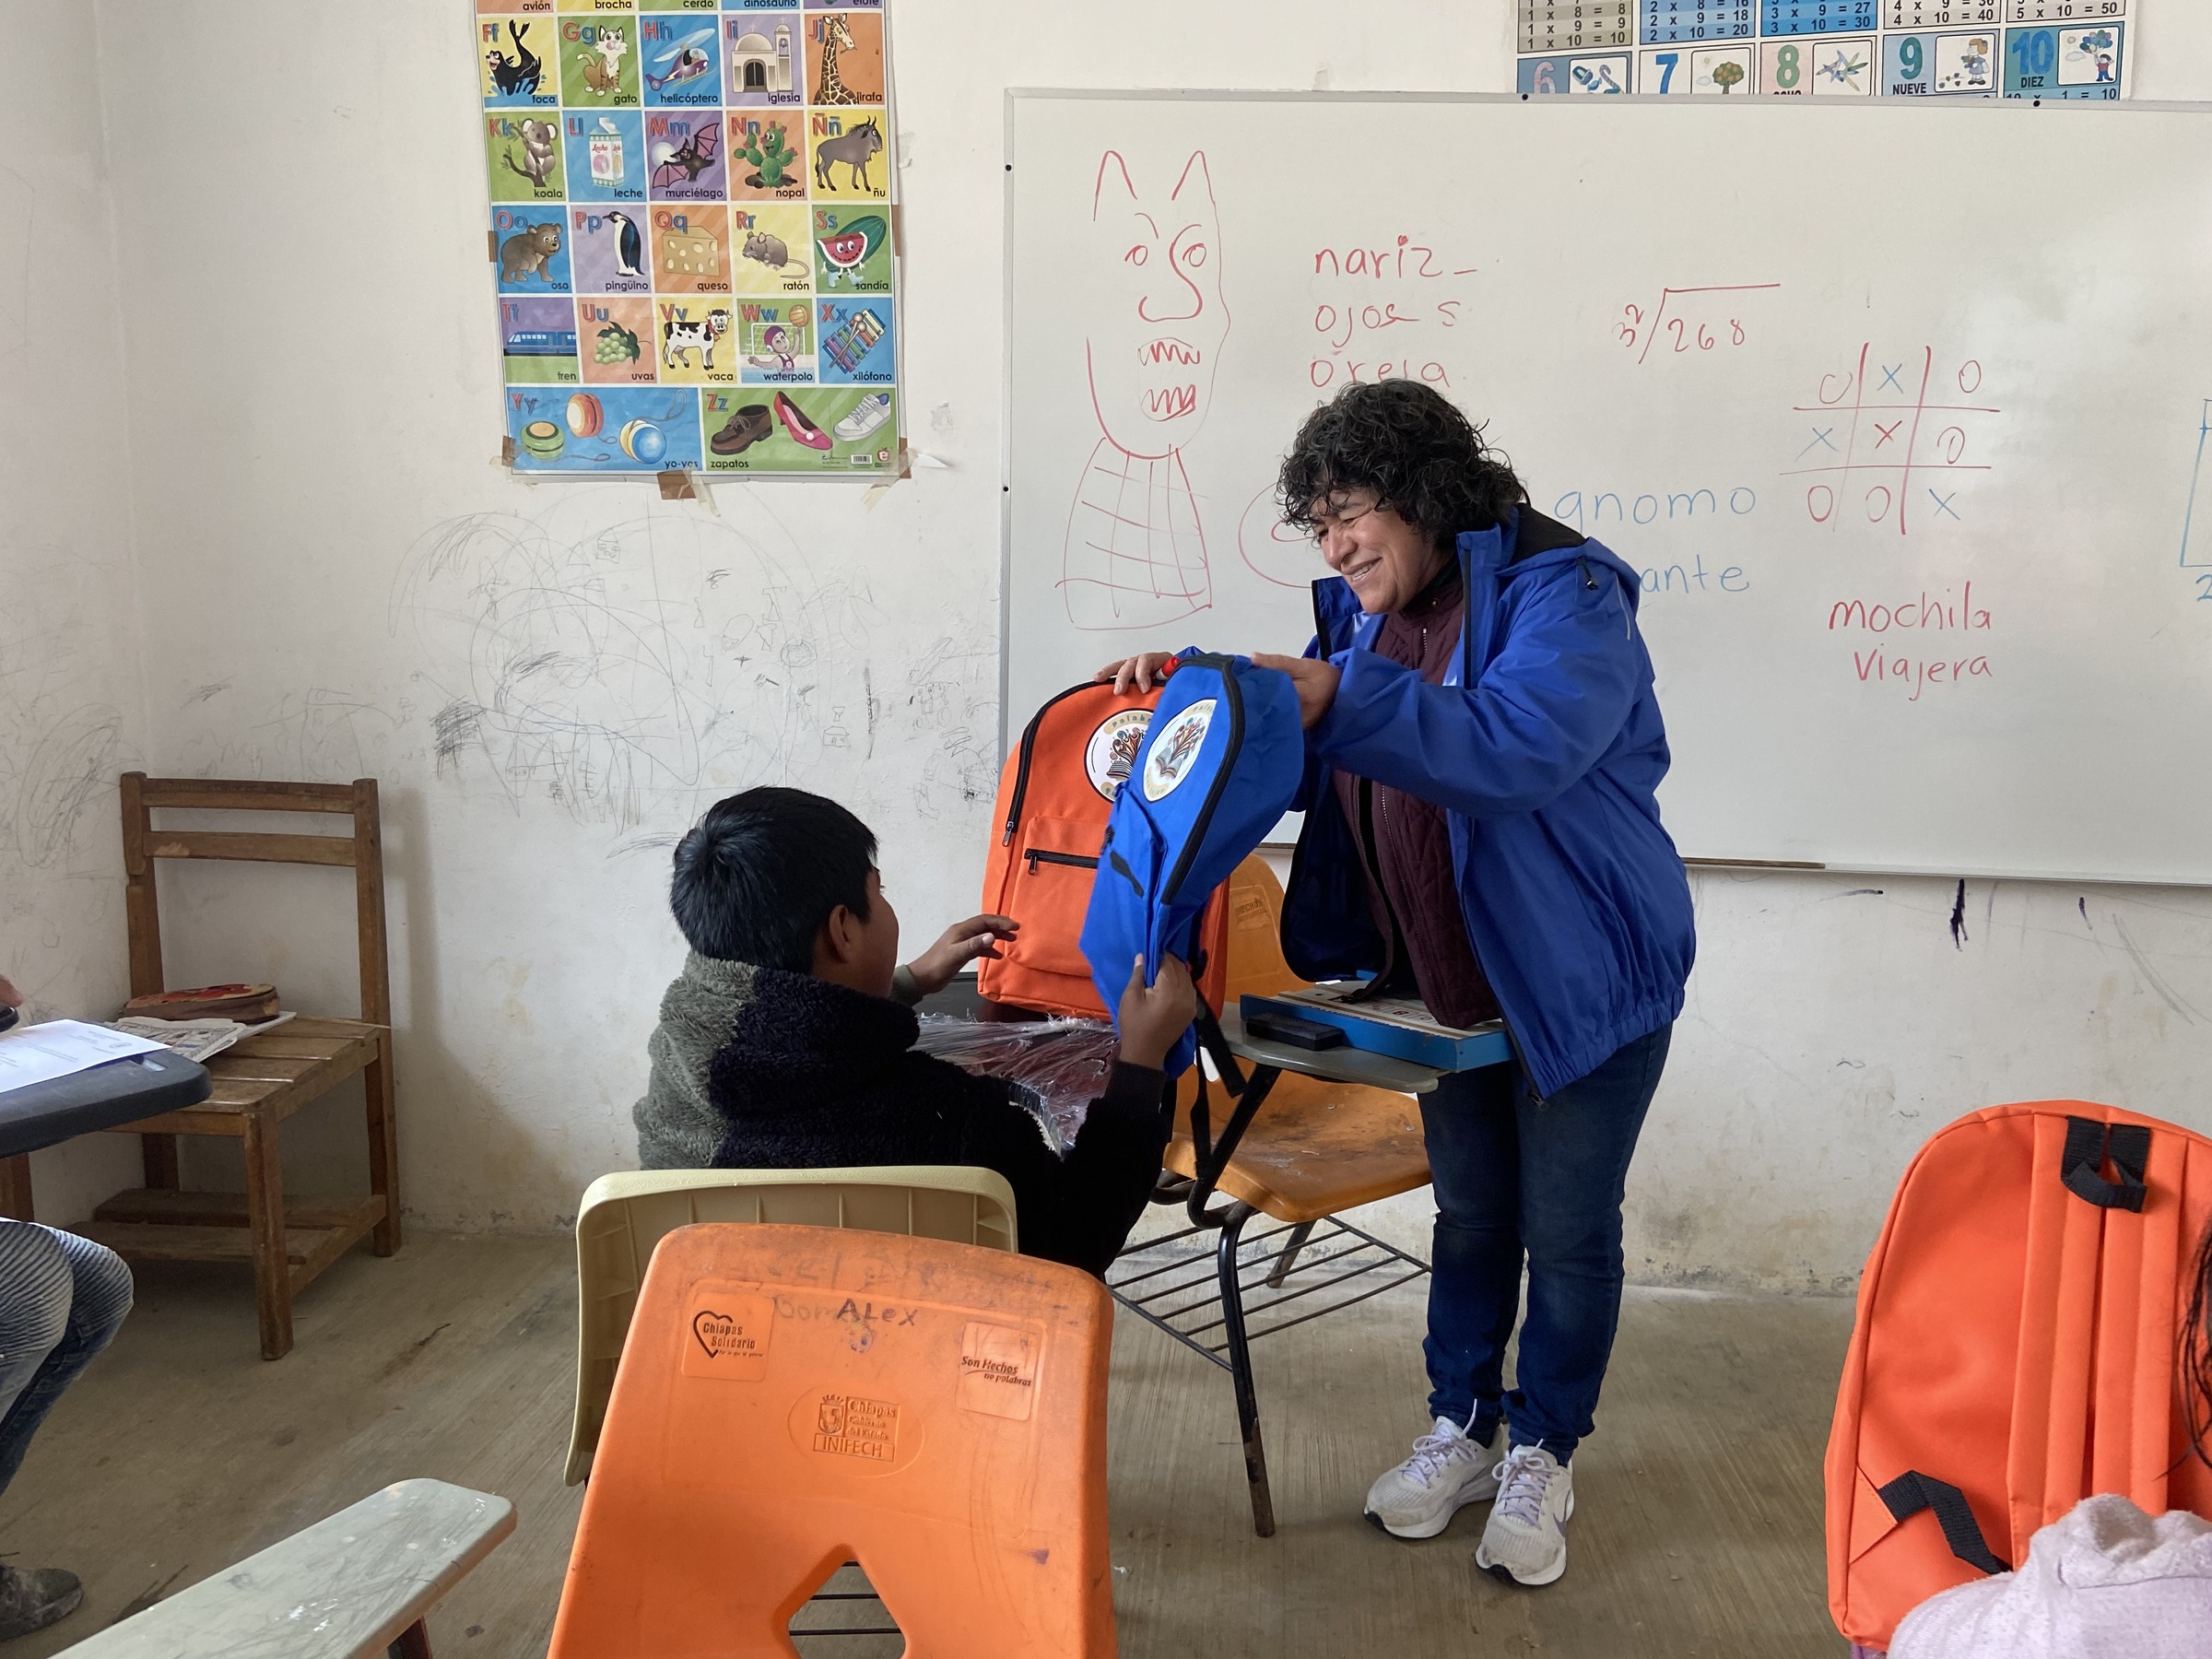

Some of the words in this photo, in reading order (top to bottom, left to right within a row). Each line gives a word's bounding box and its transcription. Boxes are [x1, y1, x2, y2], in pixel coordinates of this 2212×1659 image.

[523, 0, 551, 11] avión
[595, 0, 632, 9] brocha
[1771, 7, 1779, 18] 3
[1791, 8, 1799, 18] x
[1818, 5, 1827, 16] 9
[1854, 2, 1871, 14] 27
[2017, 7, 2024, 18] 5
[2036, 8, 2044, 18] x
[2057, 5, 2072, 17] 10
[2101, 2, 2117, 14] 50
[1528, 10, 1534, 21] 1
[1547, 11, 1554, 19] x
[1574, 6, 1583, 18] 8
[1618, 3, 1626, 15] 8
[1650, 15, 1658, 27] 2
[1669, 16, 1677, 26] x
[1697, 12, 1705, 24] 9
[1734, 9, 1748, 21] 18
[1893, 14, 1902, 26] 4
[1913, 16, 1922, 25] x
[1935, 12, 1949, 23] 10
[1978, 9, 1994, 21] 40
[1528, 24, 1534, 35] 1
[1547, 25, 1554, 34] x
[1574, 20, 1583, 32] 9
[1618, 17, 1626, 29] 9
[1771, 21, 1779, 33] 3
[1791, 23, 1798, 32] x
[1811, 18, 1826, 30] 10
[1854, 16, 1870, 28] 30
[1650, 29, 1657, 41] 2
[1669, 30, 1677, 41] x
[1689, 27, 1704, 39] 10
[1733, 24, 1748, 36] 20
[1527, 38, 1534, 50] 1
[1547, 39, 1554, 48] x
[1567, 35, 1582, 46] 10
[1610, 31, 1626, 43] 10
[1900, 37, 1923, 80] 9
[2013, 29, 2054, 75] 10
[1776, 44, 1800, 88] 8
[1534, 61, 1556, 94] 6
[1655, 53, 1678, 94] 7
[2021, 76, 2044, 88] DIEZ
[1892, 83, 1927, 95] NUEVE
[532, 94, 556, 104] foca
[614, 94, 638, 105] gato
[660, 93, 719, 105] helicóptero
[768, 92, 801, 105] iglesia
[856, 92, 883, 104] jirafa
[534, 188, 563, 199] koala
[614, 188, 643, 198] leche
[665, 187, 724, 200] murciélago
[775, 187, 806, 199] nopal
[873, 187, 886, 198] ñu
[1315, 235, 1443, 278] nariz
[551, 281, 569, 290] oso
[605, 279, 649, 292] pingüino
[697, 281, 729, 292] queso
[782, 279, 809, 290] ratón
[855, 279, 889, 290] sandía
[557, 371, 577, 381] tren
[631, 372, 654, 381] uvas
[707, 372, 734, 382] vaca
[763, 371, 814, 383] waterpolo
[853, 371, 893, 382] xilófono
[711, 459, 749, 470] zapatos
[1829, 581, 1991, 632] mochila
[703, 1323, 743, 1336] Chiapas
[711, 1335, 756, 1349] Solidario
[960, 1356, 981, 1369] Son
[982, 1359, 1019, 1374] Hechos
[995, 1374, 1032, 1386] palabras
[848, 1399, 897, 1418] Chiapas
[847, 1415, 886, 1429] Gobierno
[860, 1429, 888, 1441] Estado
[822, 1436, 883, 1458] INIFECH
